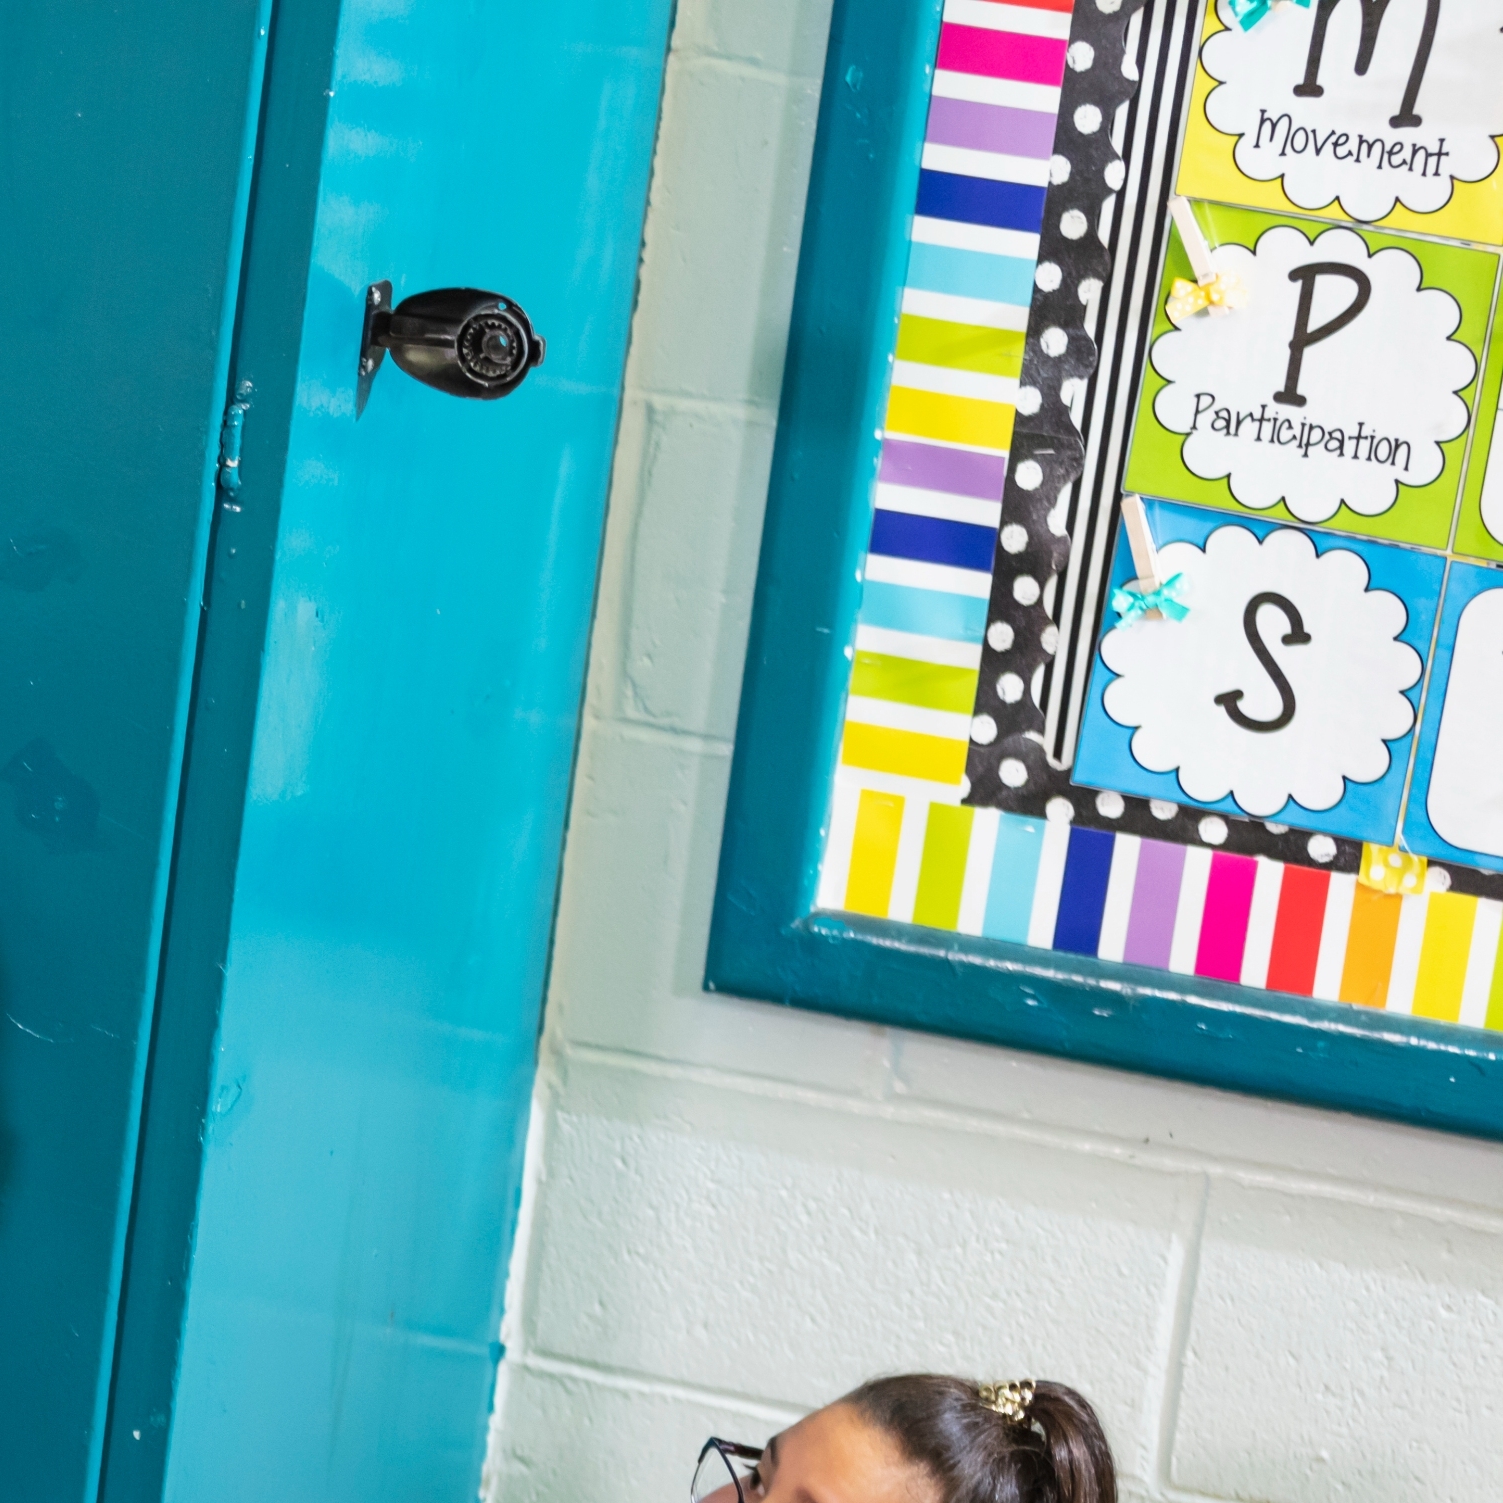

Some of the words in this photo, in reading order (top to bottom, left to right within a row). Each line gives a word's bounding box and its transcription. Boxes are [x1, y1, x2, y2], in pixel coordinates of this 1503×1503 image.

[1253, 109, 1450, 178] Movement
[1272, 262, 1371, 408] P
[1190, 393, 1412, 472] Participation
[1214, 592, 1311, 733] S
